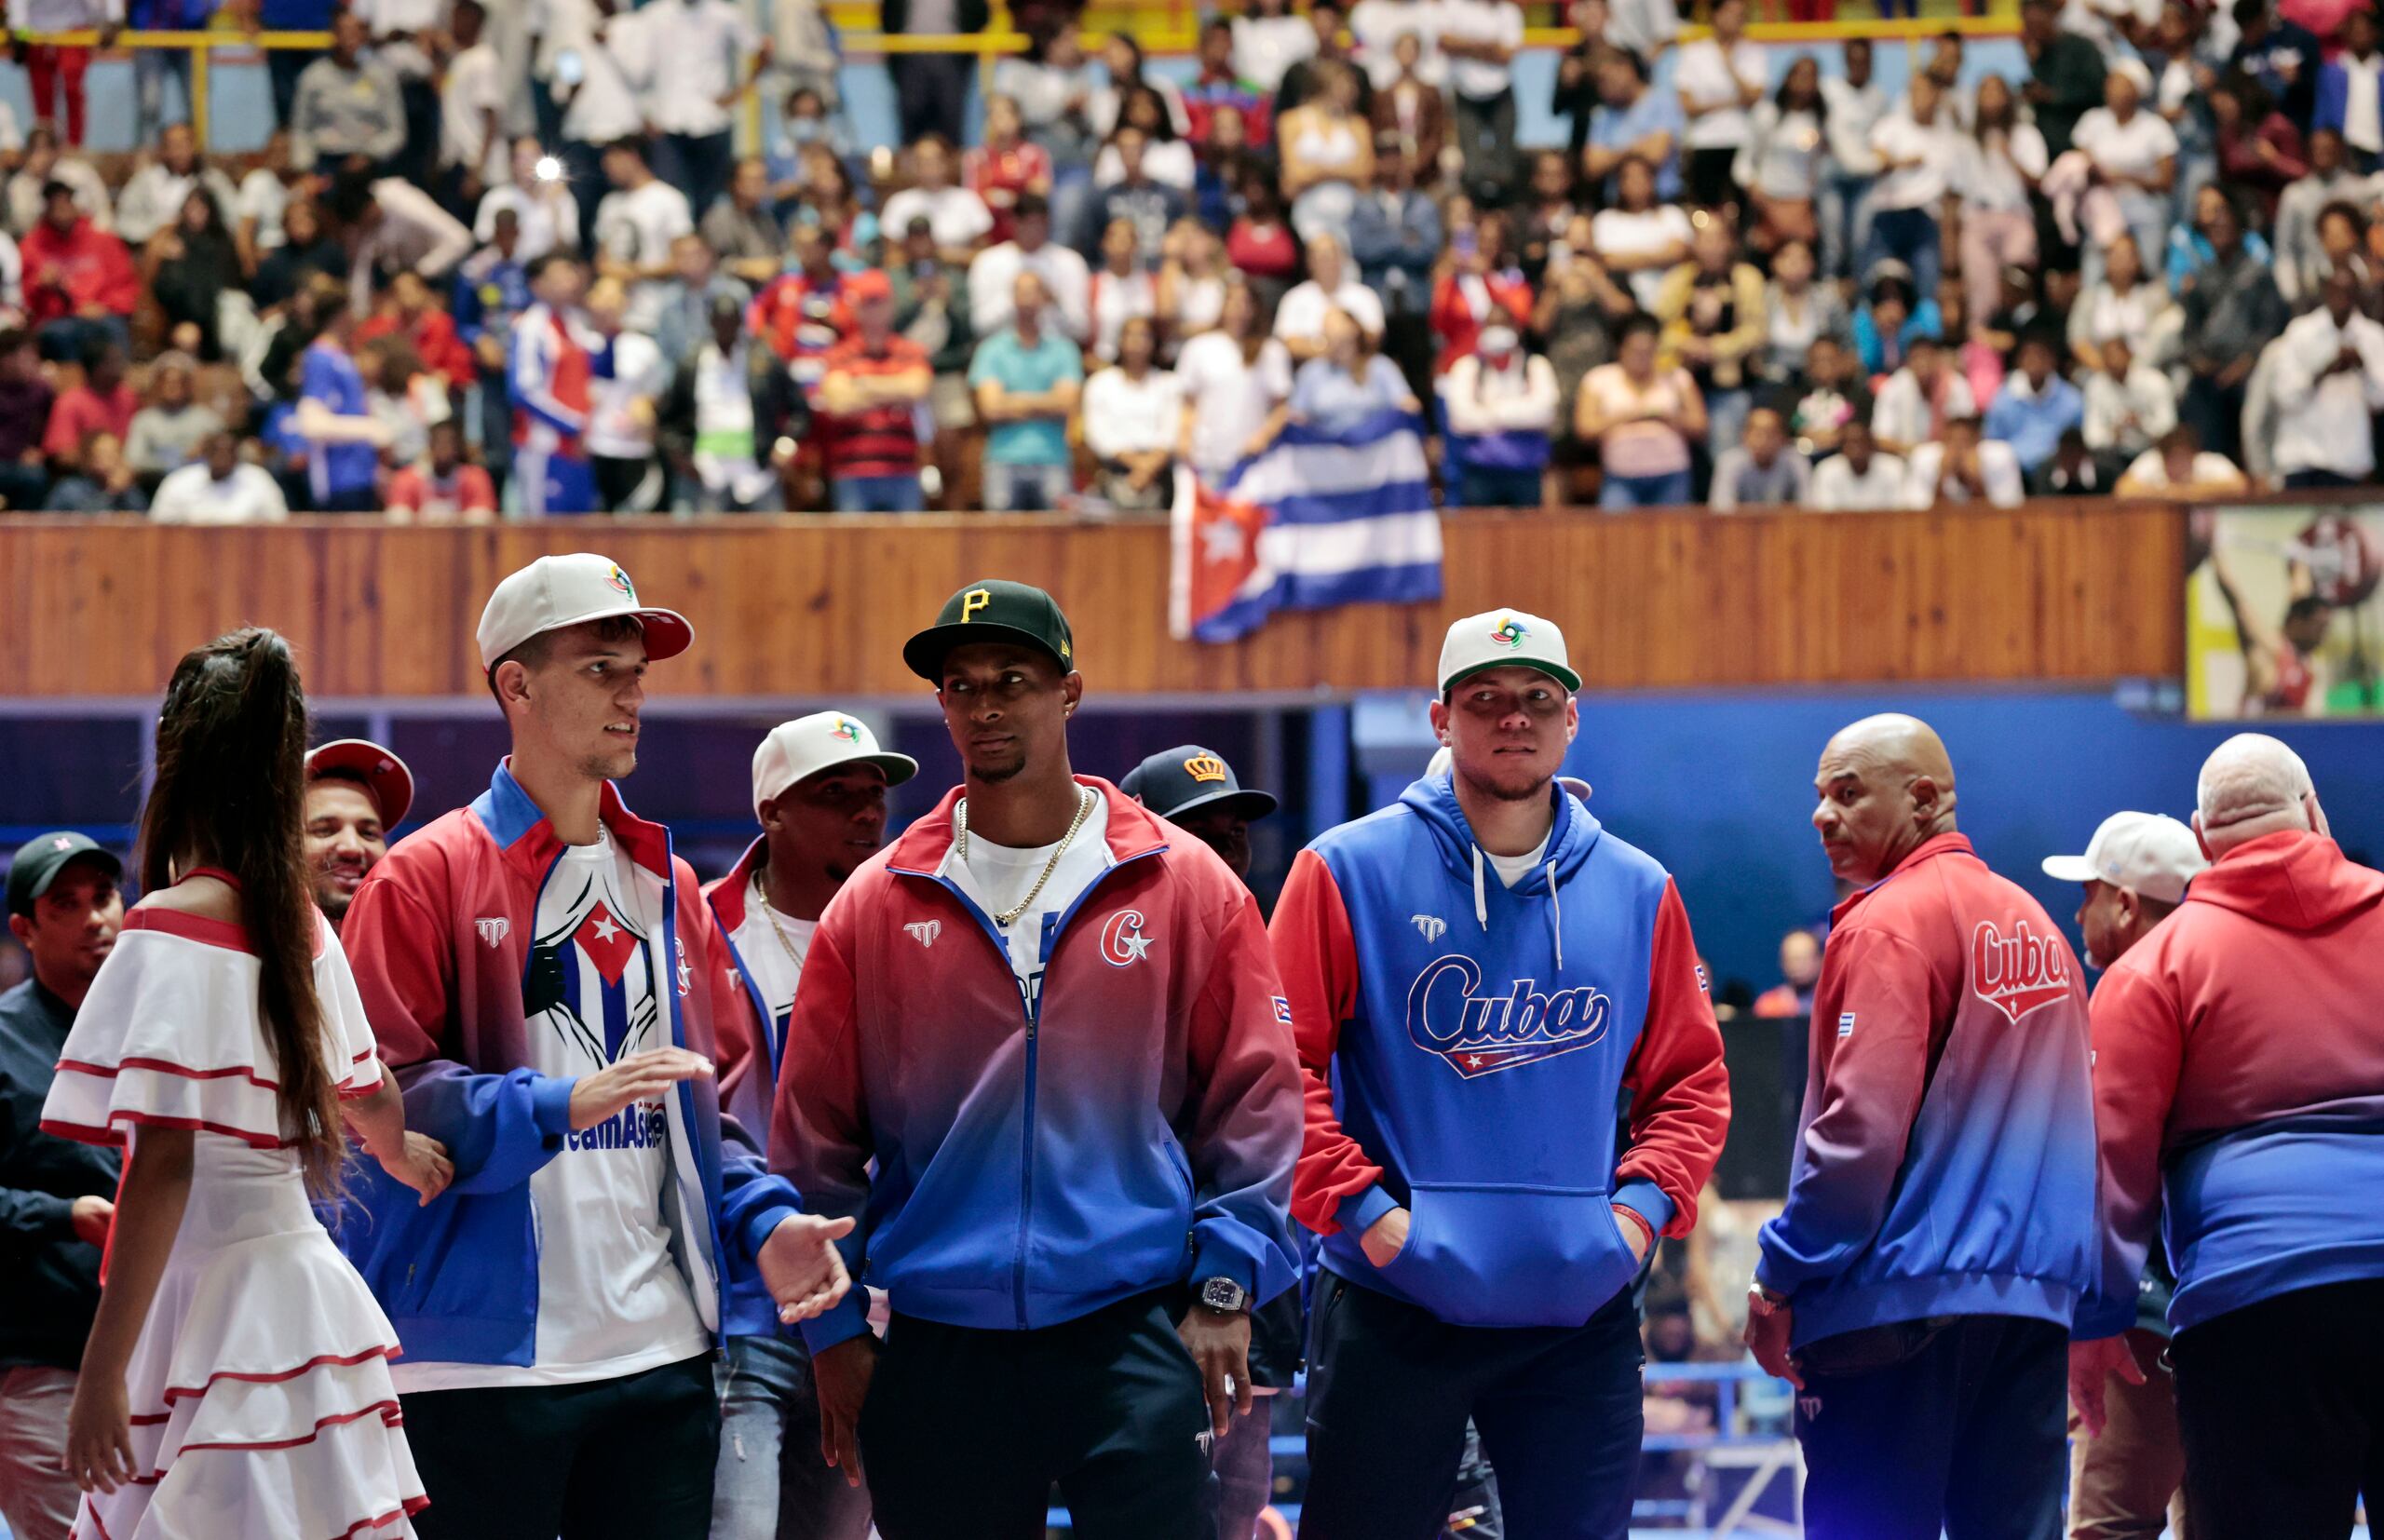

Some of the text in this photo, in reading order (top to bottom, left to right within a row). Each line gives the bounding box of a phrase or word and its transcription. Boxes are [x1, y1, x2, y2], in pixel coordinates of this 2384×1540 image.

[961, 588, 991, 624] P
[1972, 920, 2069, 998] Cuba
[1407, 954, 1610, 1055] Cuba
